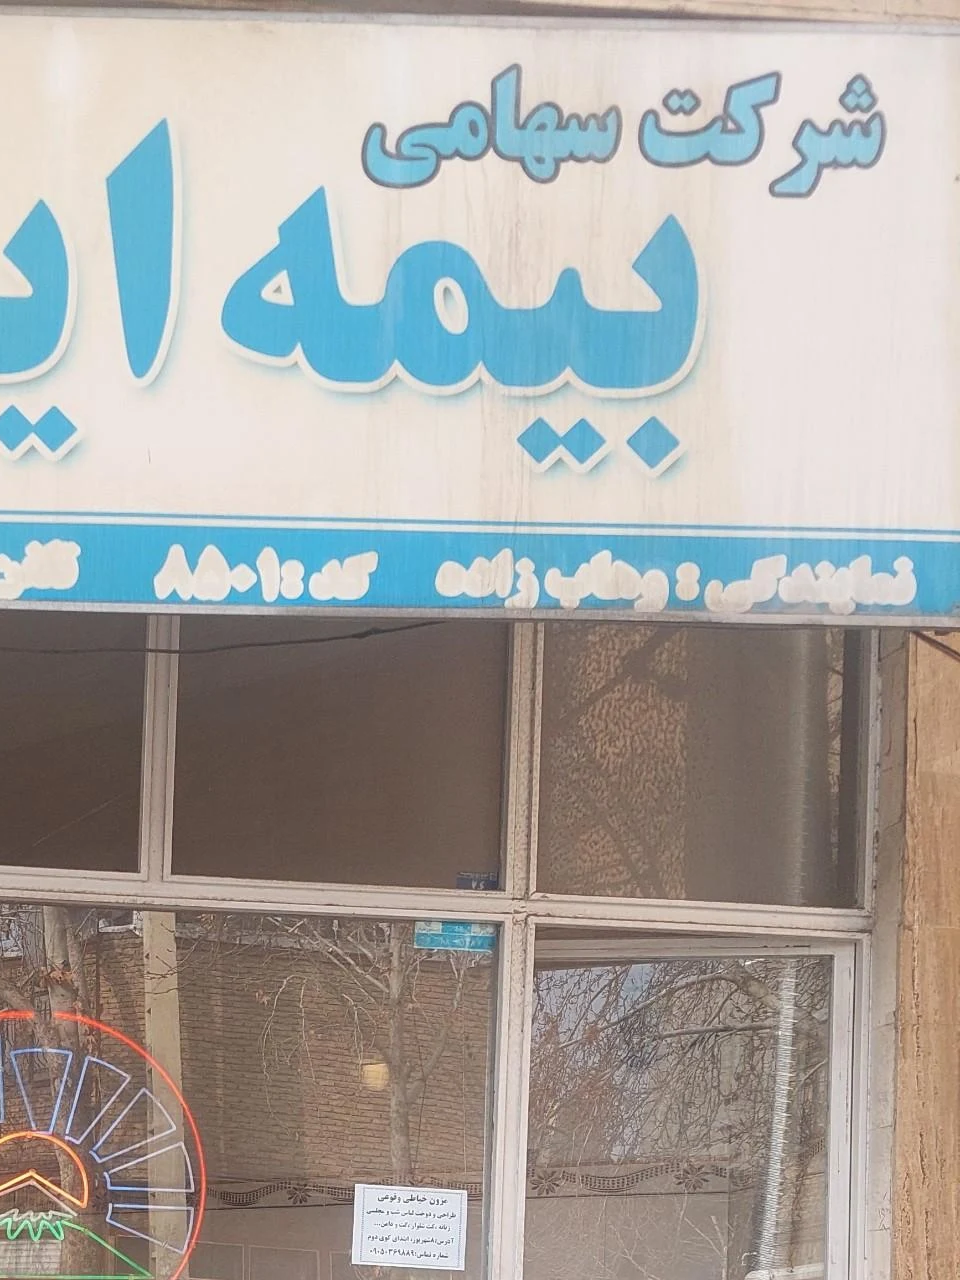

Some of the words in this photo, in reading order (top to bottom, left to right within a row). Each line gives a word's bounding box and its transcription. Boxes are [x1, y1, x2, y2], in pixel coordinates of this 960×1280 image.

[361, 63, 622, 188] سهامی
[639, 71, 887, 198] شرکت
[220, 184, 704, 474] بیمه
